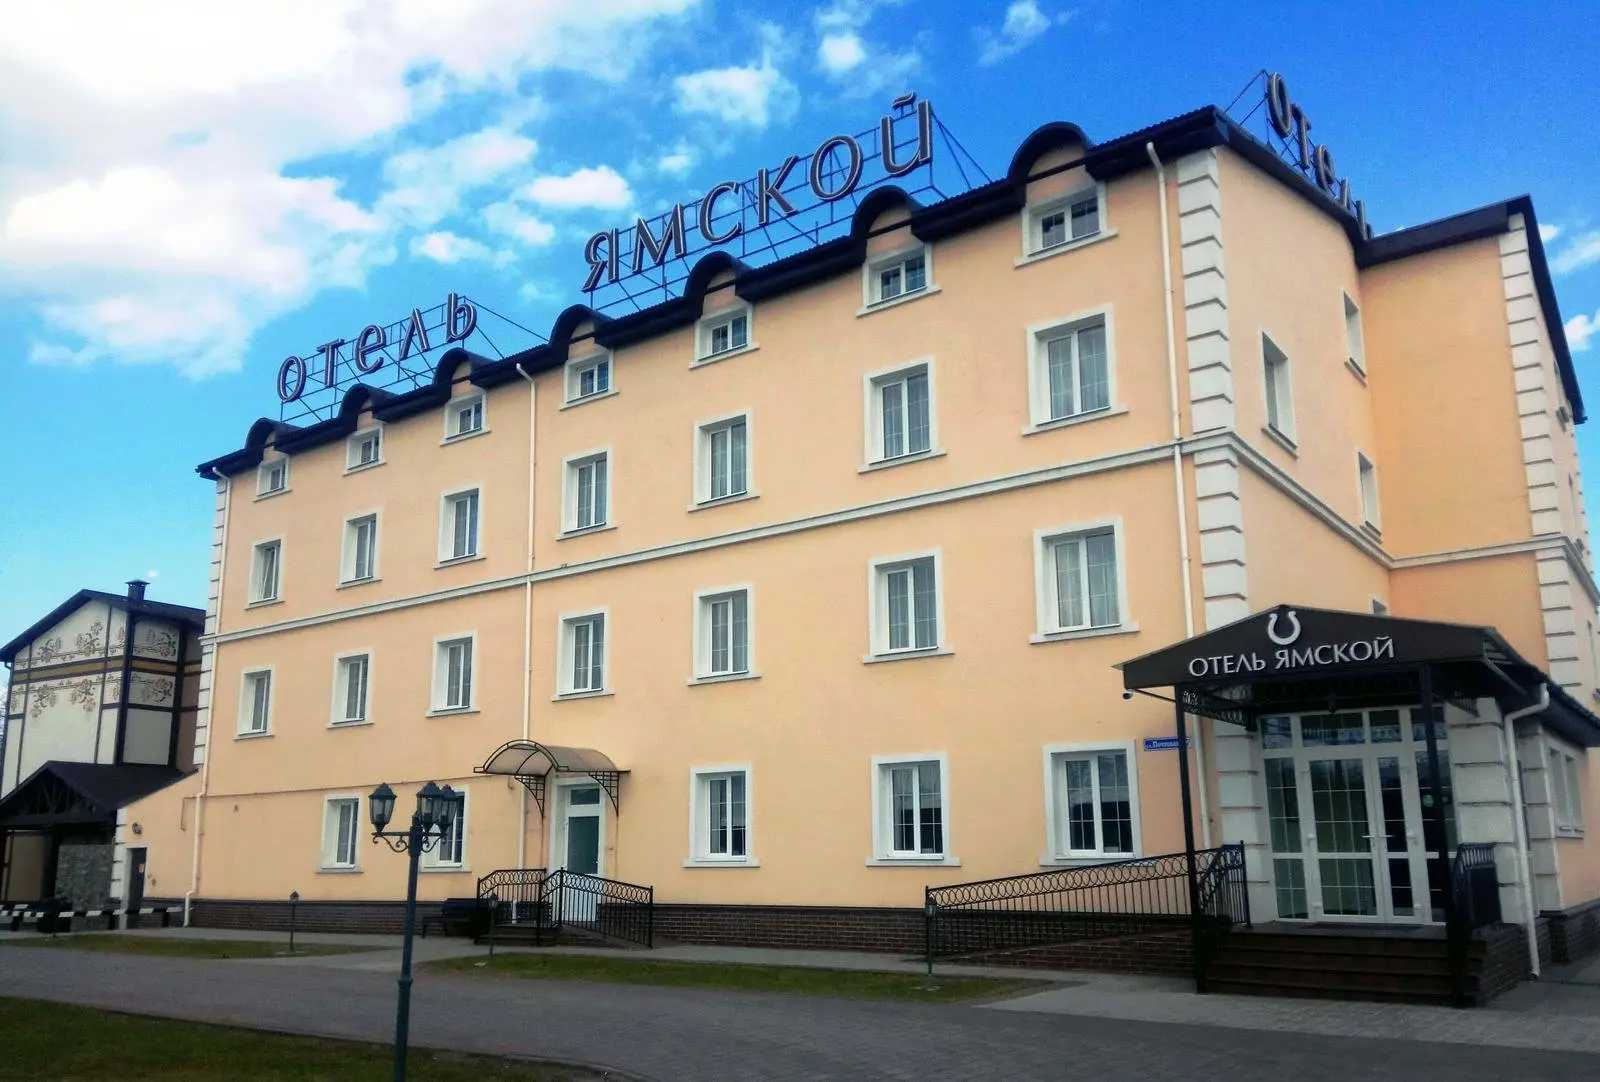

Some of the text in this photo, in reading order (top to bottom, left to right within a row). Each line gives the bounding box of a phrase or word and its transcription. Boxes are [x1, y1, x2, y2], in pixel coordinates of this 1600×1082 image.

[581, 92, 933, 292] ЯМСКОЙ
[1189, 636, 1394, 677] ОТЕЛЬ ЯМСКОЙ
